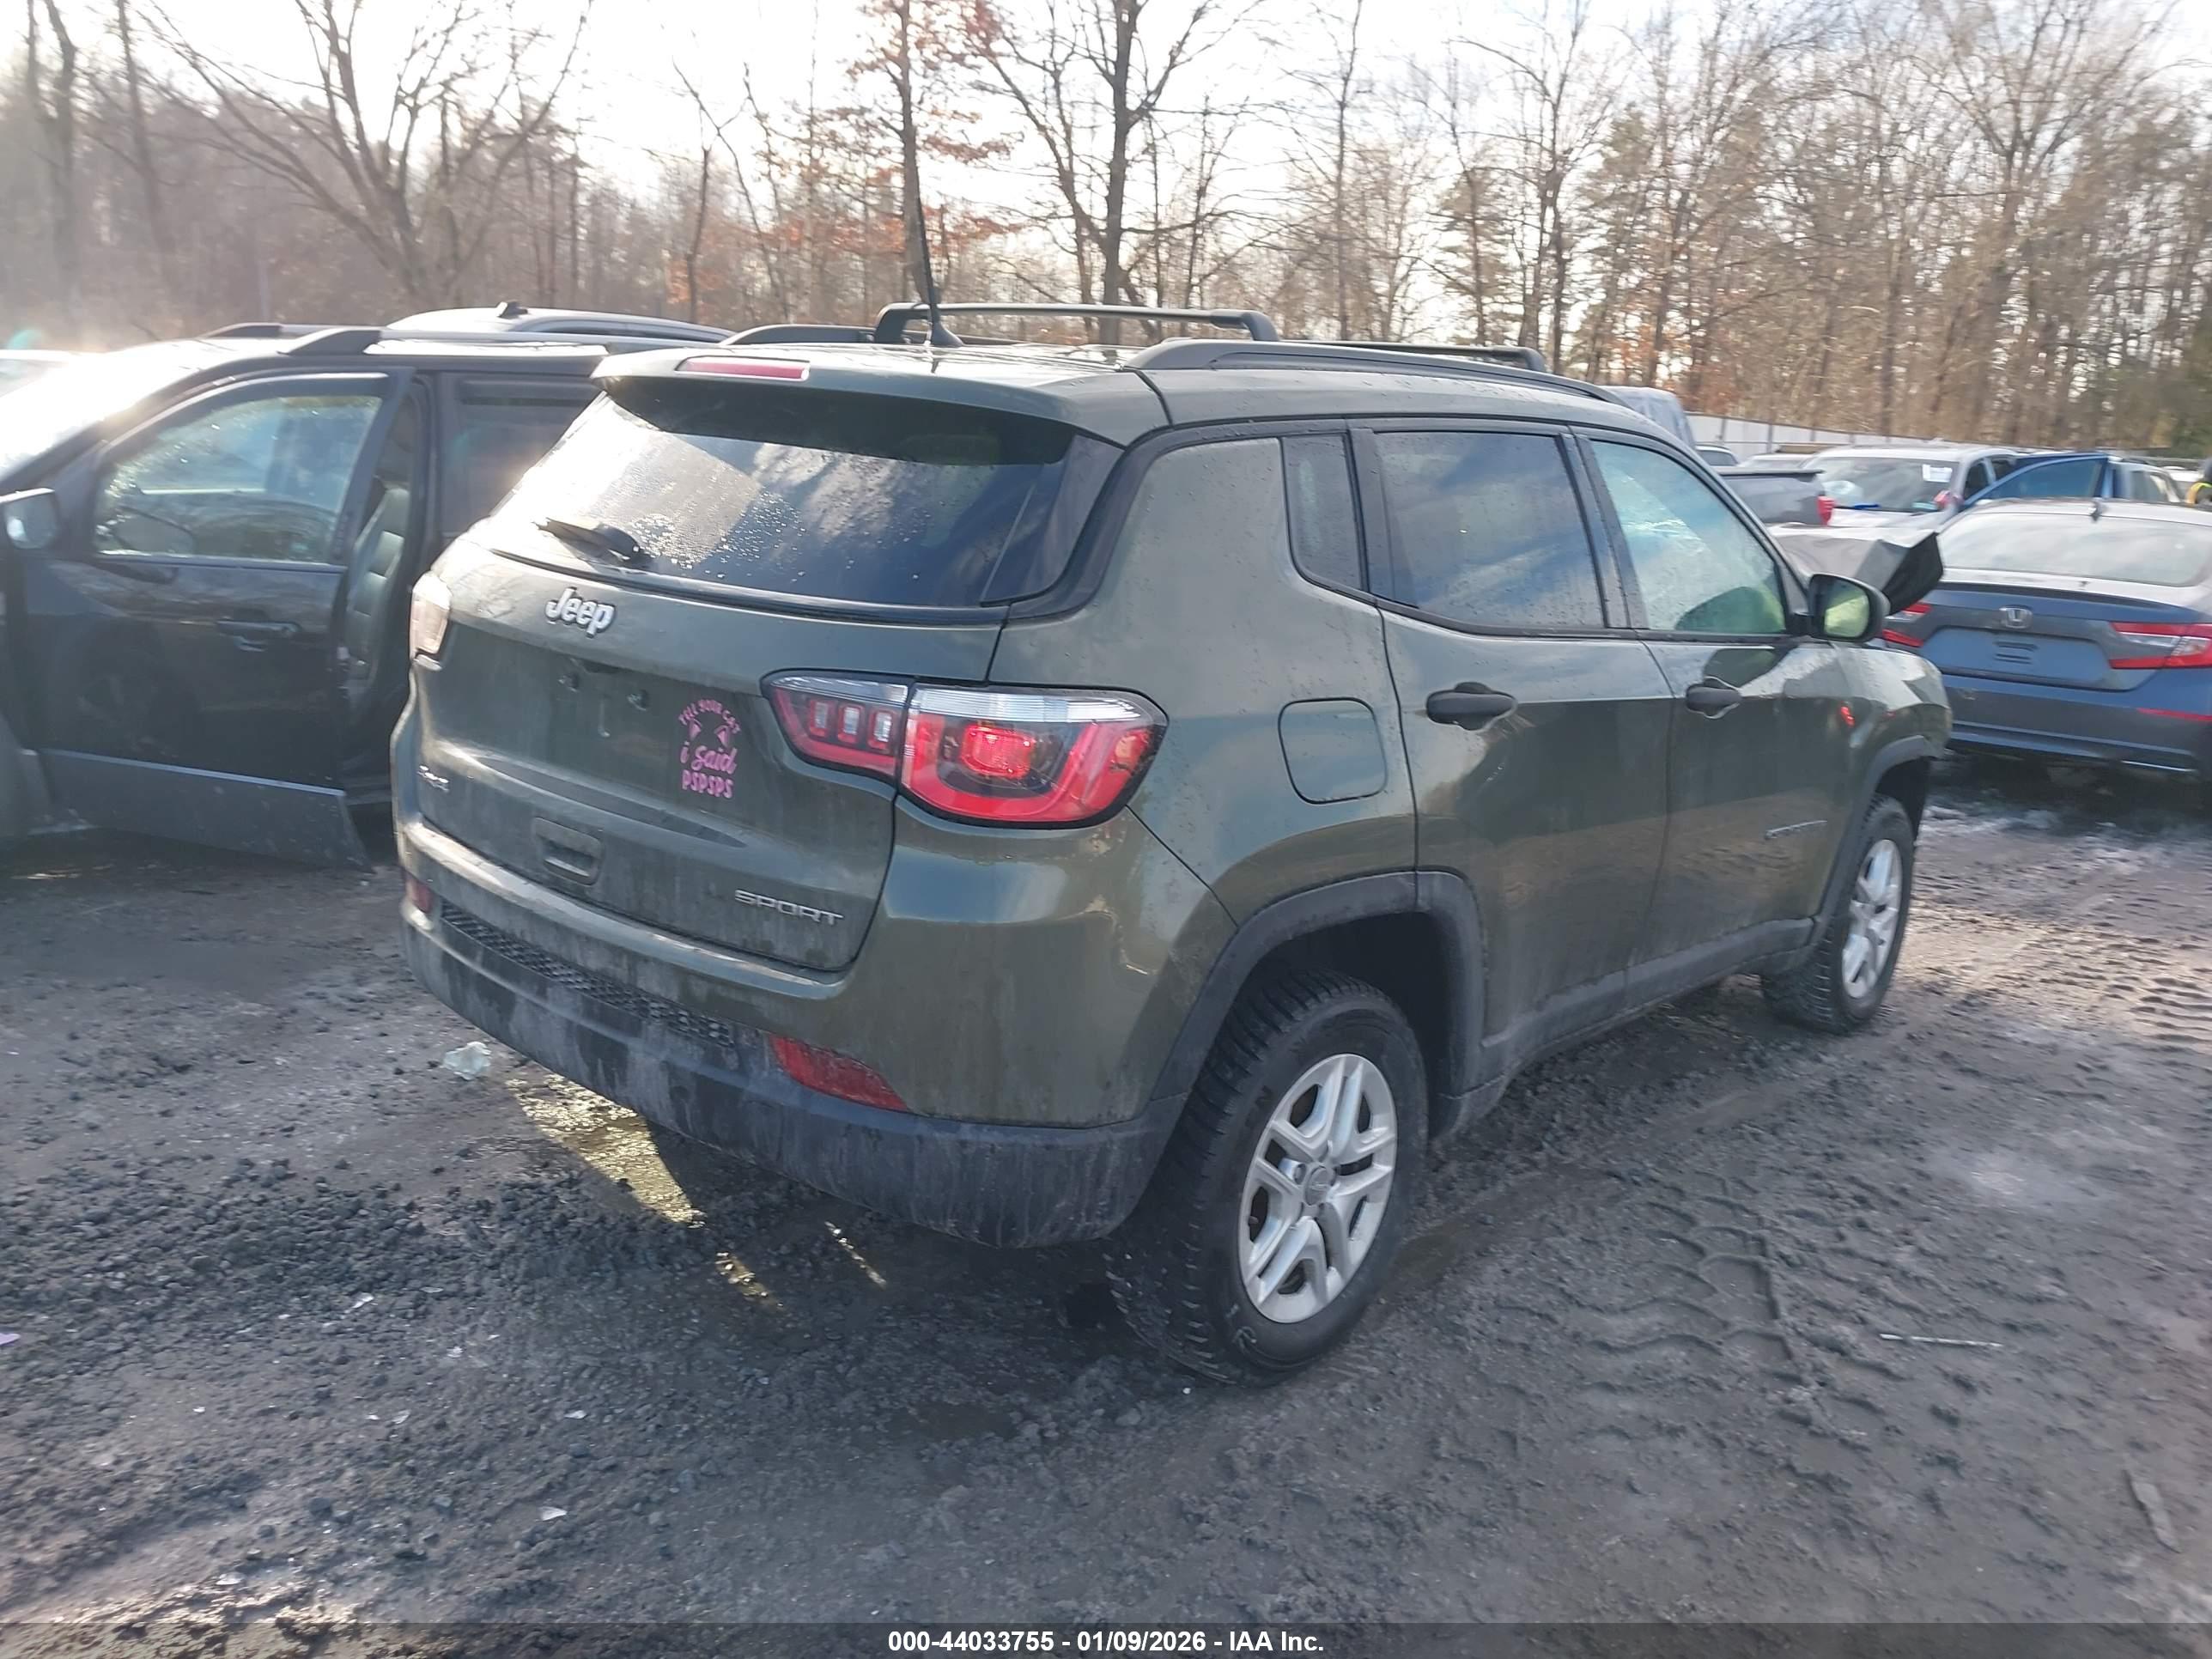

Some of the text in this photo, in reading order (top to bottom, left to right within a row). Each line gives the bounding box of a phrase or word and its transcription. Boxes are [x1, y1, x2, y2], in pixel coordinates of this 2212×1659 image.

[544, 586, 616, 638] Jeep
[691, 745, 738, 775] said
[735, 889, 844, 925] SPORT
